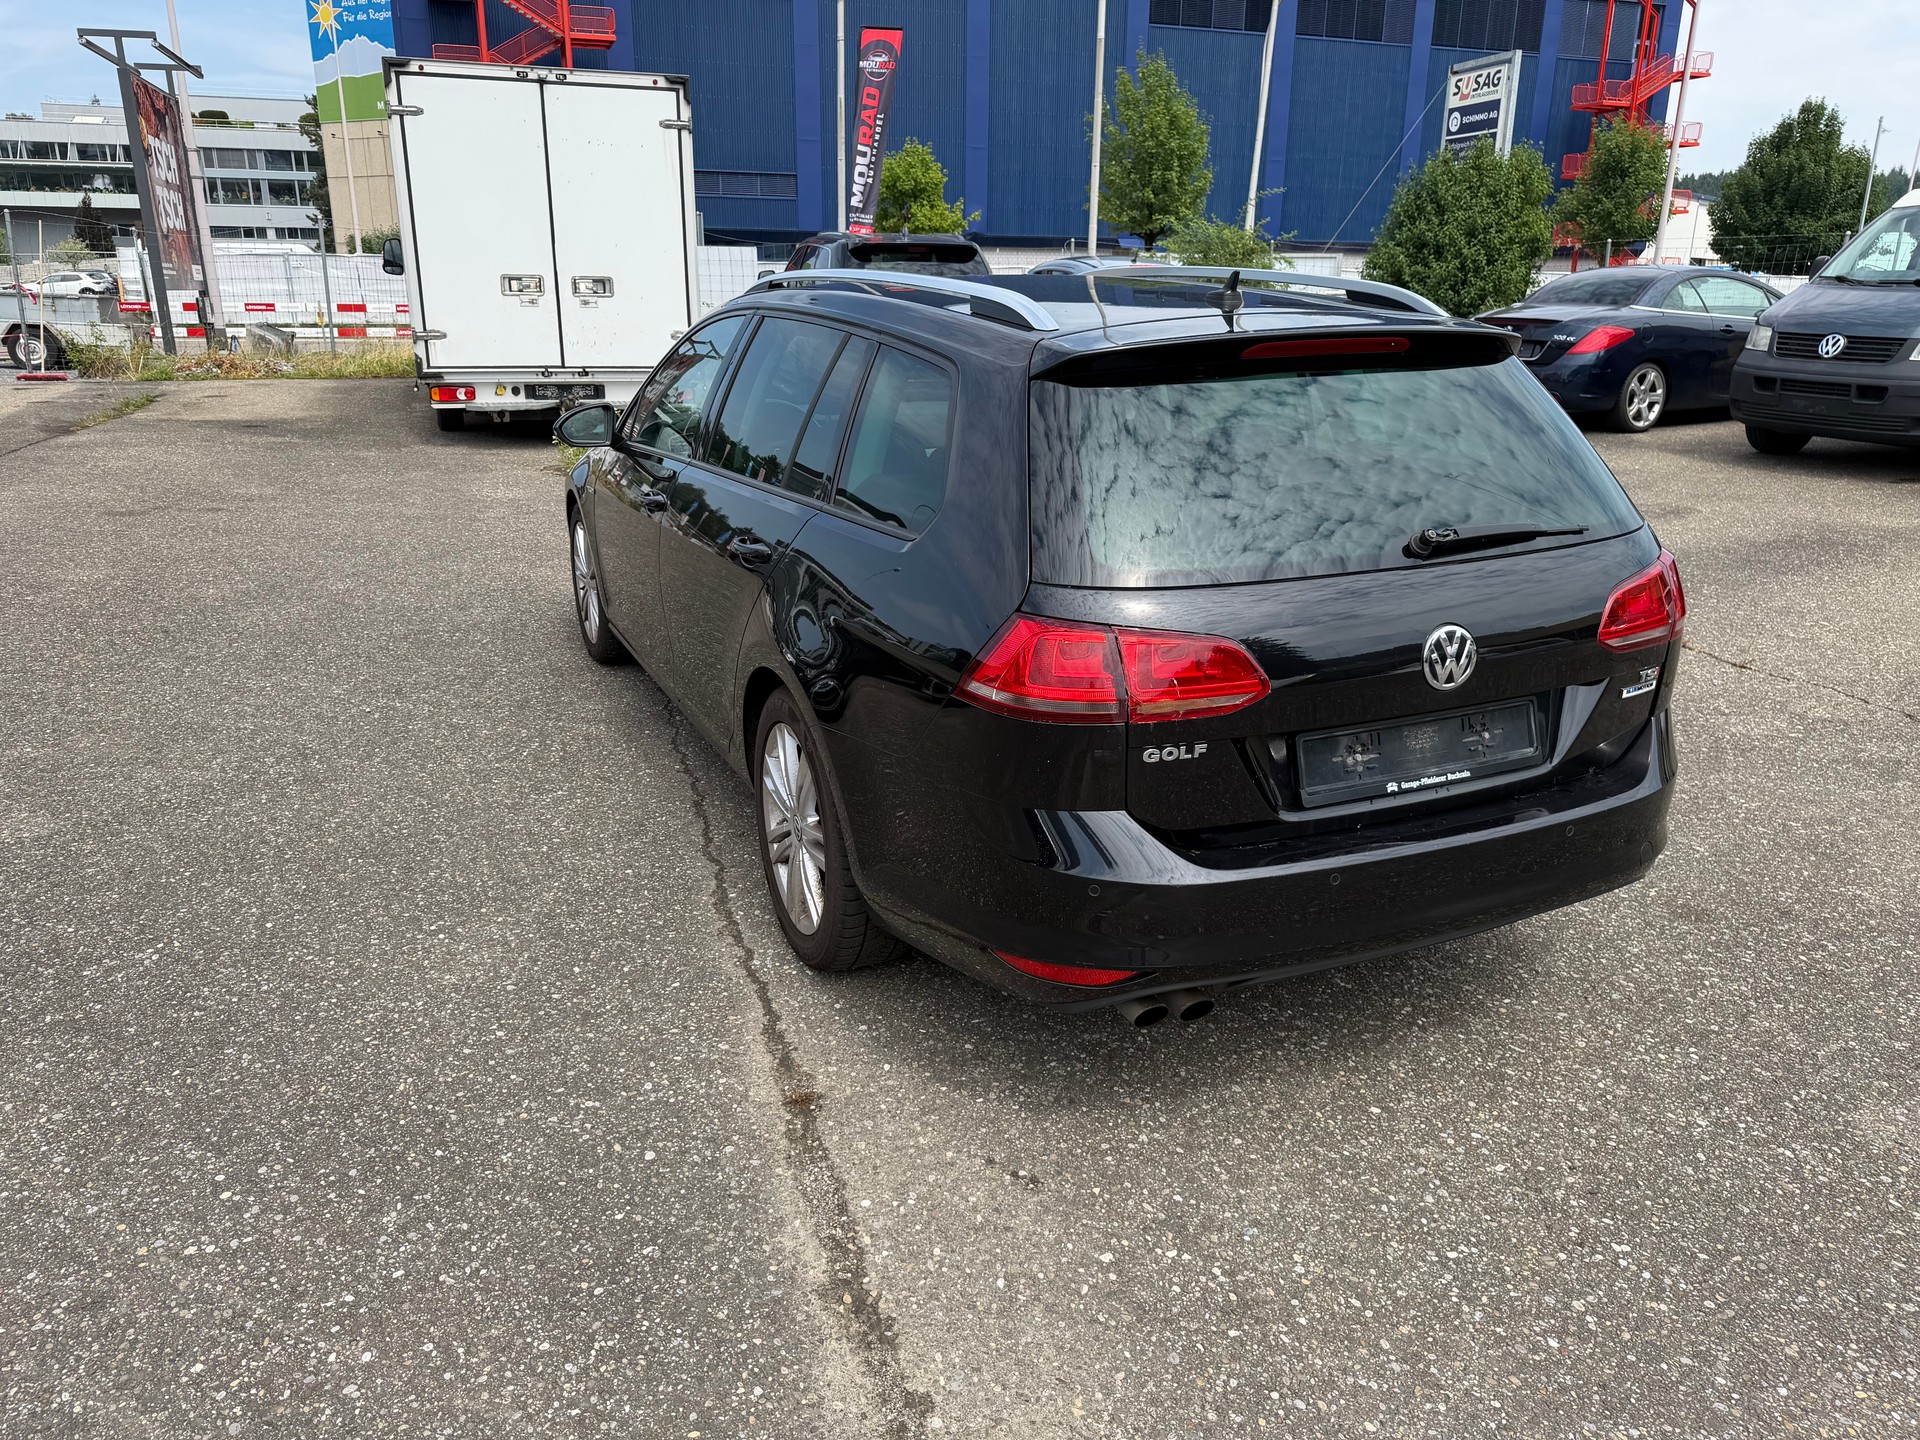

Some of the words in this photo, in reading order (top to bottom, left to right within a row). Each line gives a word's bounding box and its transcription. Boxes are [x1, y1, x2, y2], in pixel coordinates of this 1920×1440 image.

[342, 11, 355, 22] Für
[356, 11, 367, 21] die
[859, 60, 896, 69] MOURAD
[1452, 69, 1502, 101] SUSAG
[1462, 112, 1488, 124] SCHIMMO
[1489, 110, 1498, 118] AG
[147, 134, 180, 186] TSCH
[850, 86, 881, 208] MOURAD
[866, 112, 885, 184] AUTOHANDEL
[1425, 626, 1475, 689] VW
[1142, 743, 1208, 763] GOLF
